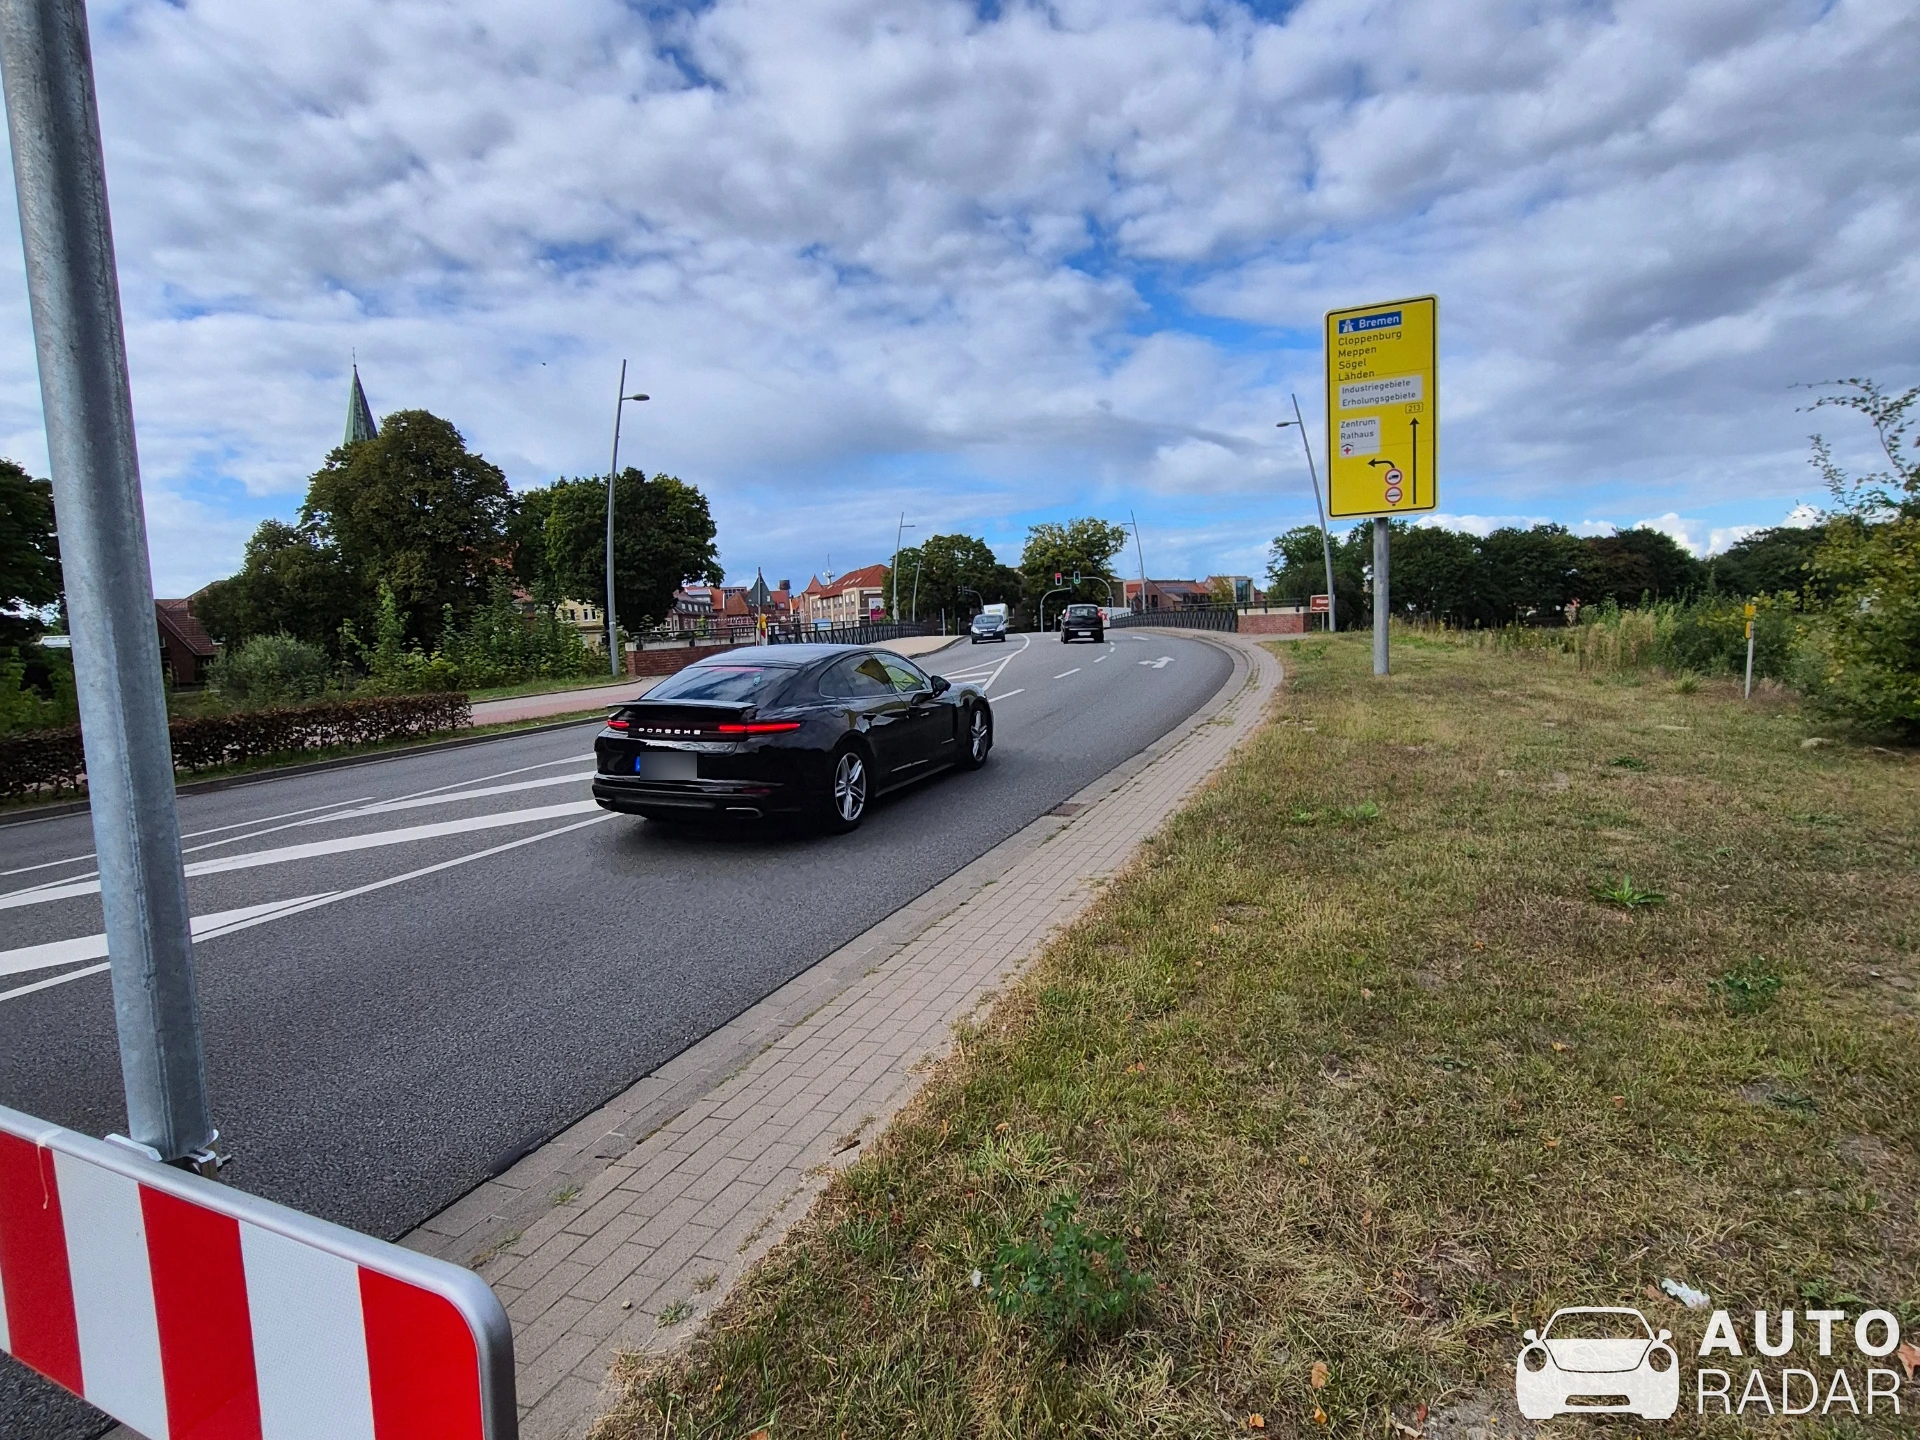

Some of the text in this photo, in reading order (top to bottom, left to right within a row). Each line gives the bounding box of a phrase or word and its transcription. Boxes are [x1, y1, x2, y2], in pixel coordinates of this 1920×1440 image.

[1359, 316, 1399, 328] Bremen
[1338, 331, 1402, 346] Cloppenburg
[1338, 346, 1377, 358] Meppen
[1338, 358, 1367, 370] Sögel
[1338, 370, 1375, 381] Lähden
[1342, 380, 1411, 394] Industriegebiete
[1342, 392, 1416, 407] Erholungsgebiete
[1408, 403, 1421, 412] 213
[1340, 419, 1376, 429] Zentrum
[1340, 431, 1375, 440] Rathaus
[638, 727, 701, 735] PORSCHE
